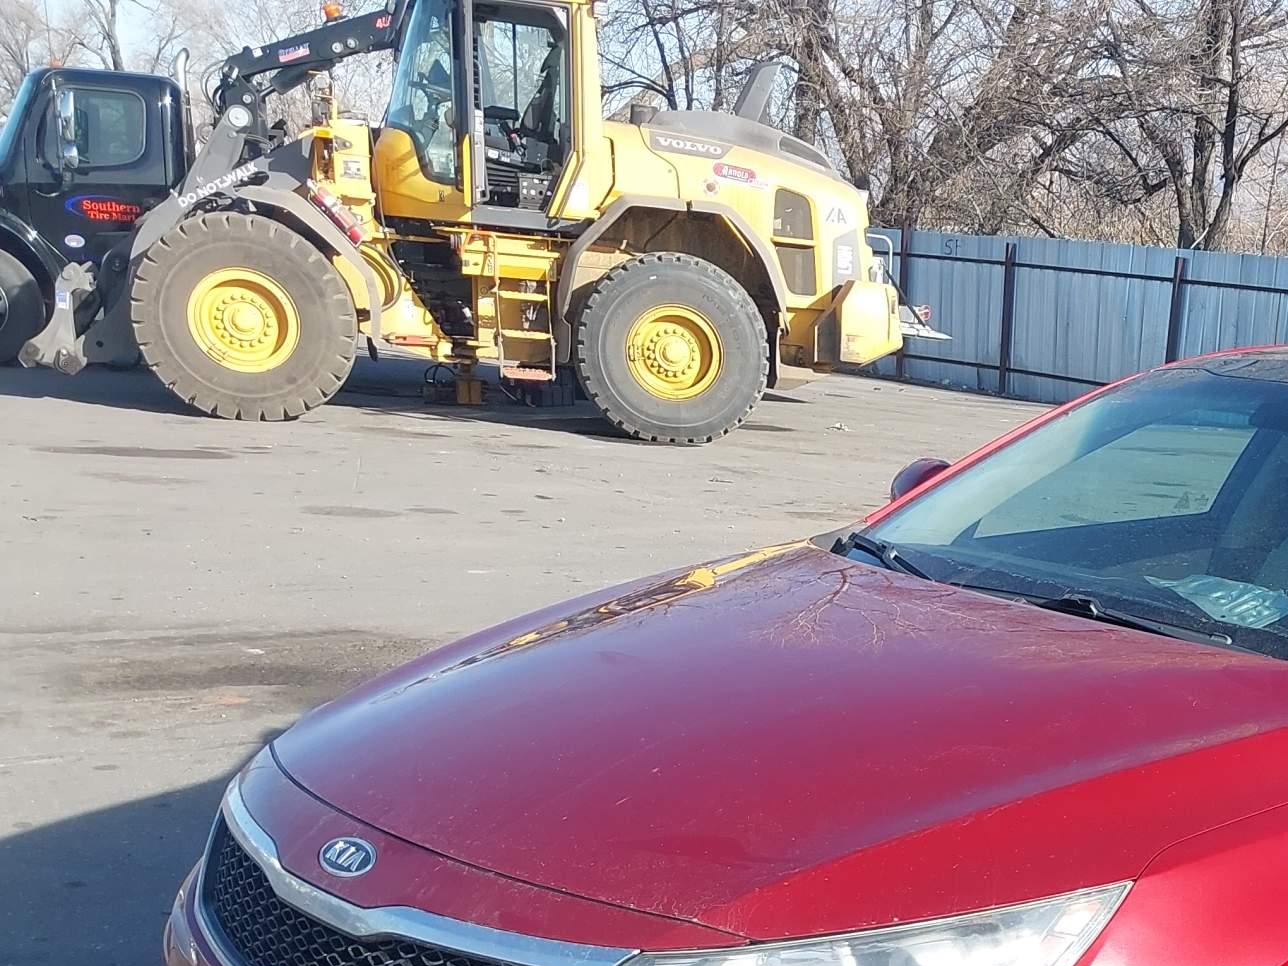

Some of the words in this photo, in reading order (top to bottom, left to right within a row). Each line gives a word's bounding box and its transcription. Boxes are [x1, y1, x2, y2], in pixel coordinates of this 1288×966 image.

[656, 136, 722, 154] VOLVO
[178, 192, 197, 207] DO
[196, 177, 224, 198] NOT
[222, 161, 258, 187] WALK
[82, 199, 140, 213] Southern
[88, 210, 110, 220] Tire
[325, 840, 366, 872] KIA
